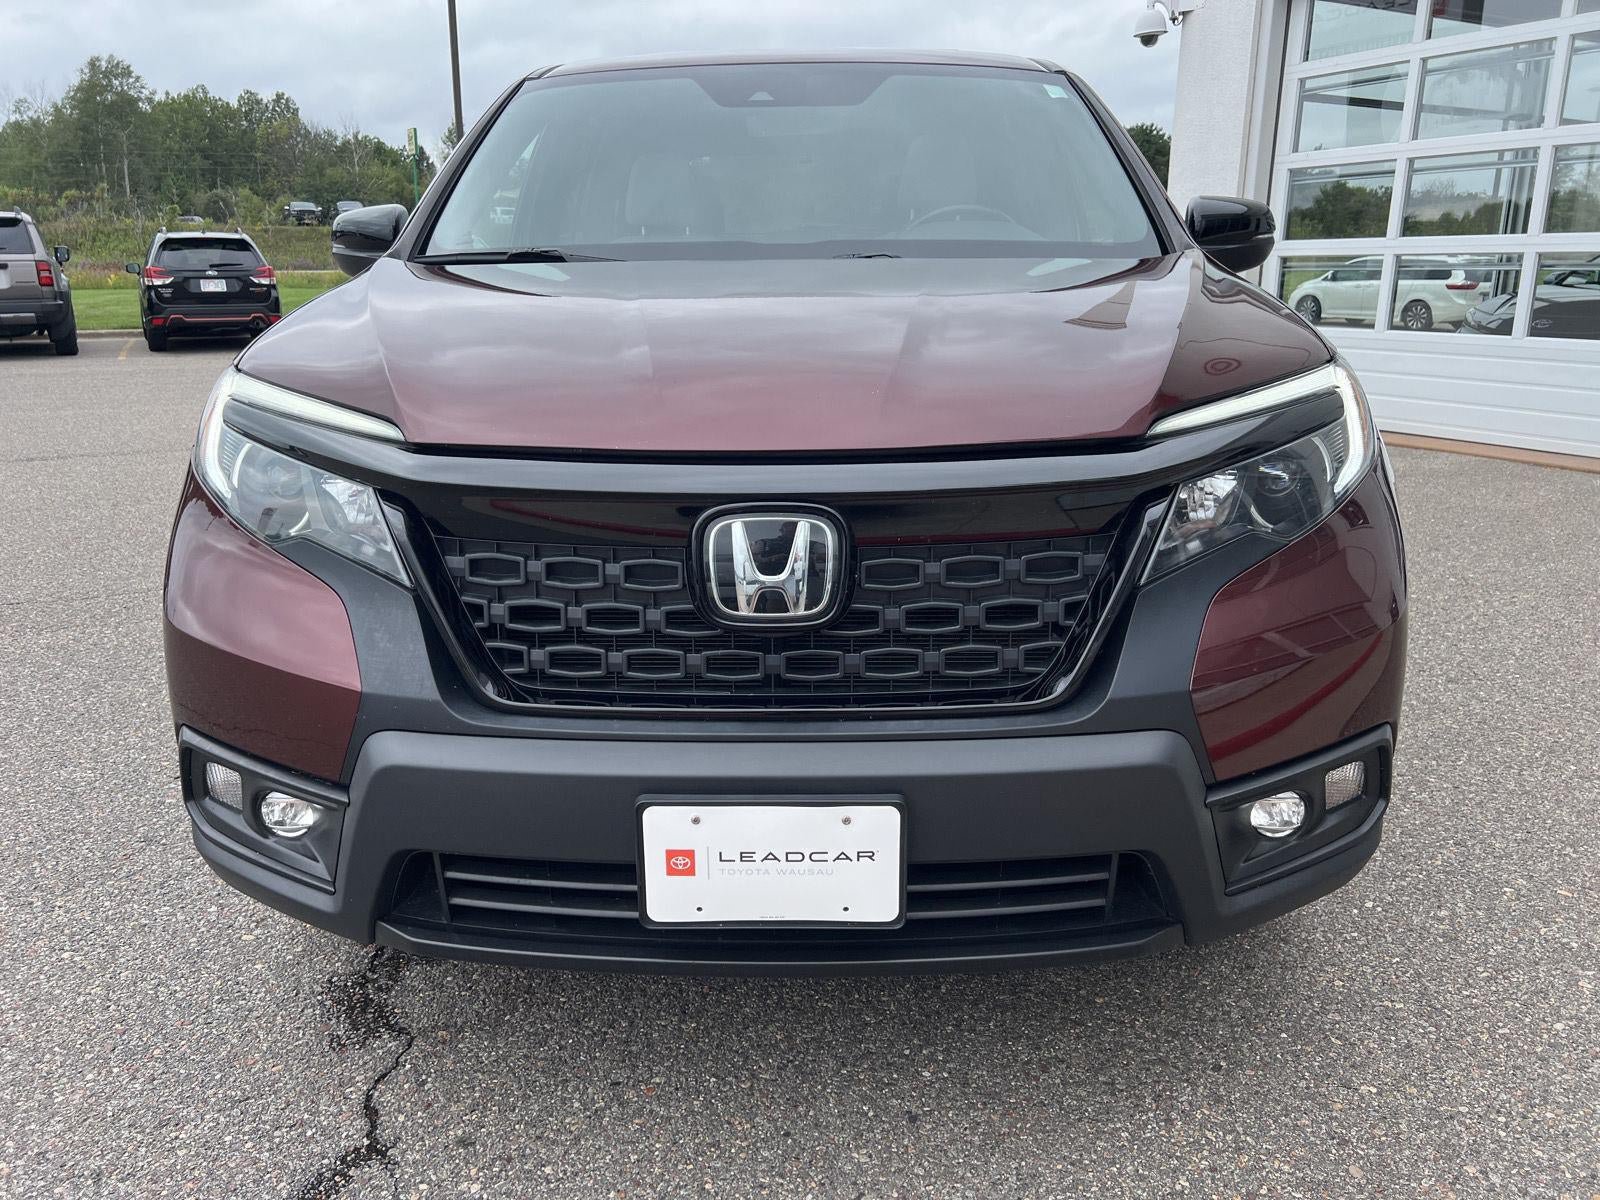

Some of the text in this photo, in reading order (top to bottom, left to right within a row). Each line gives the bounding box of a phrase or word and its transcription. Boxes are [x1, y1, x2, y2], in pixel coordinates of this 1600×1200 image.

[718, 850, 876, 863] LEADCAR
[718, 867, 835, 877] TOYOTA WAUSAU
